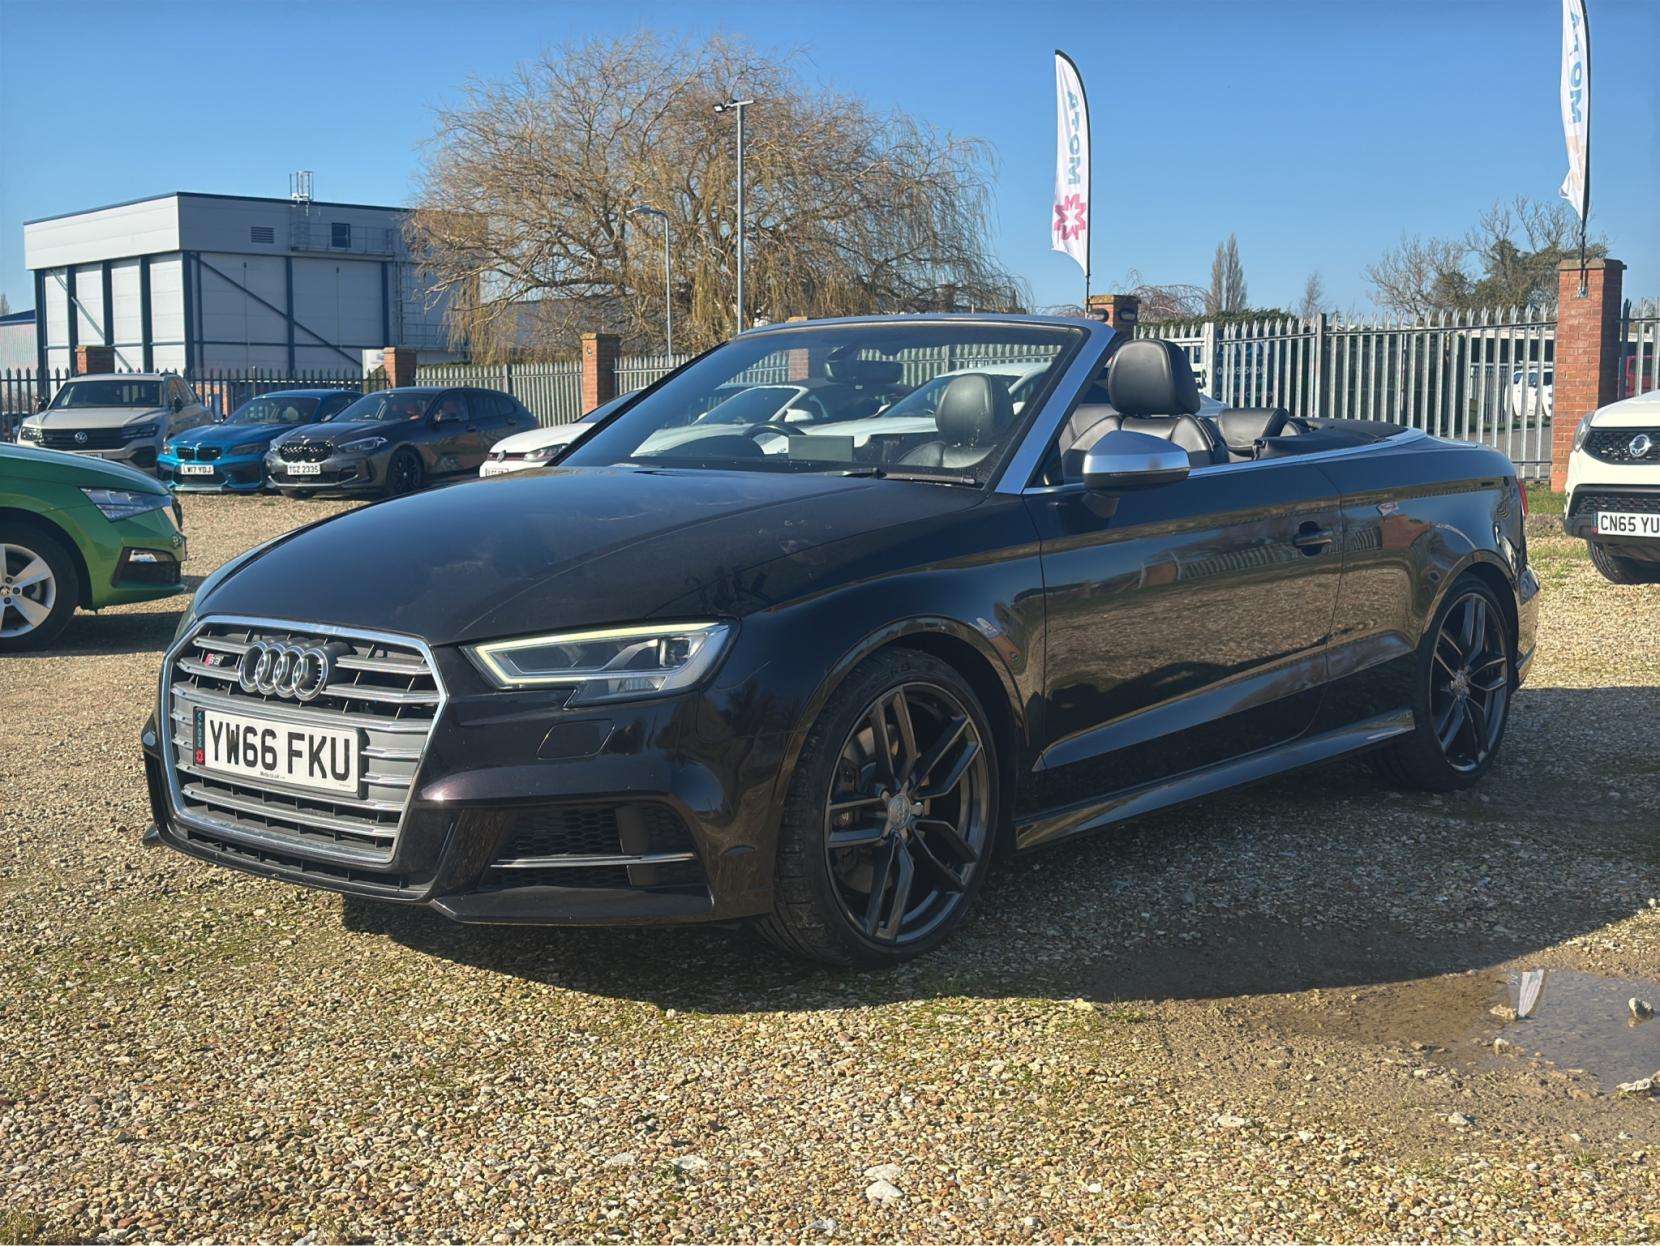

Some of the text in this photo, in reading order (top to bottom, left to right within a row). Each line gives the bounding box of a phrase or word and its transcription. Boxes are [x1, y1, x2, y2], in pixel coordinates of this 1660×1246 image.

[1601, 515, 1636, 532] CN65
[209, 720, 350, 781] YW66 FKU
